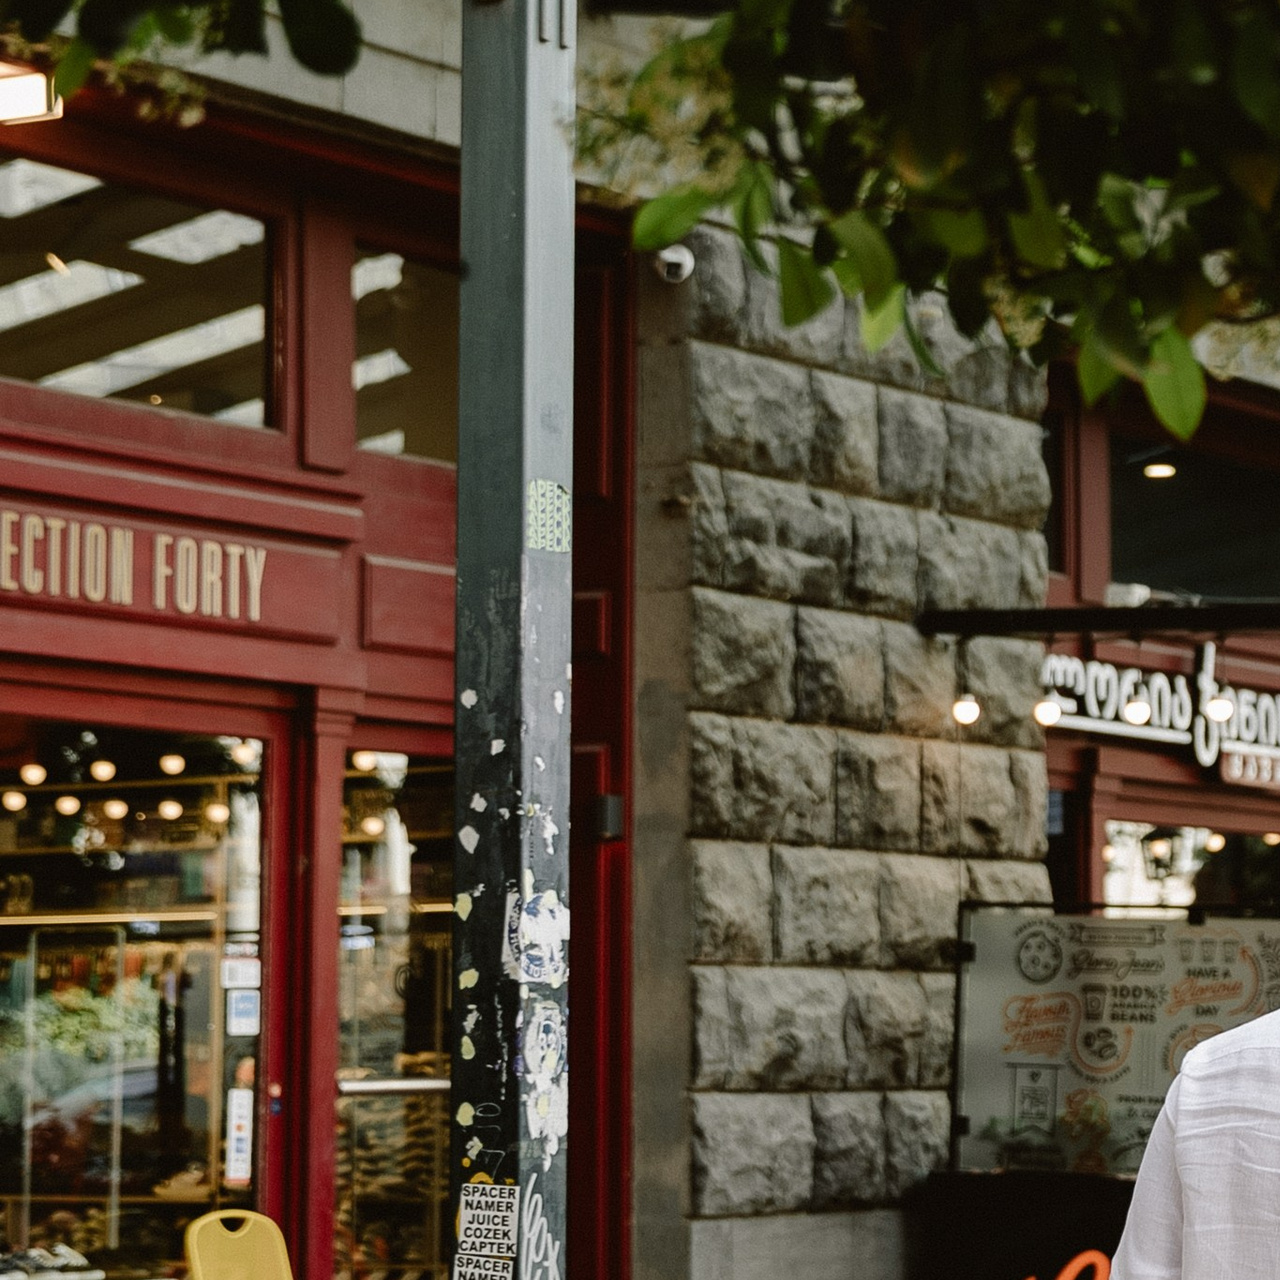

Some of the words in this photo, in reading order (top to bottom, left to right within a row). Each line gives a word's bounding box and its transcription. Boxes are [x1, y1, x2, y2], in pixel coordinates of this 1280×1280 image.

[0, 511, 134, 596] ECTION
[154, 533, 267, 622] FORTY
[462, 1185, 517, 1200] SPACER
[464, 1199, 514, 1213] NAMER
[468, 1213, 510, 1227] JUICE
[464, 1226, 512, 1241] COZEK
[459, 1240, 516, 1255] CAPTEK
[456, 1256, 510, 1274] SPACER
